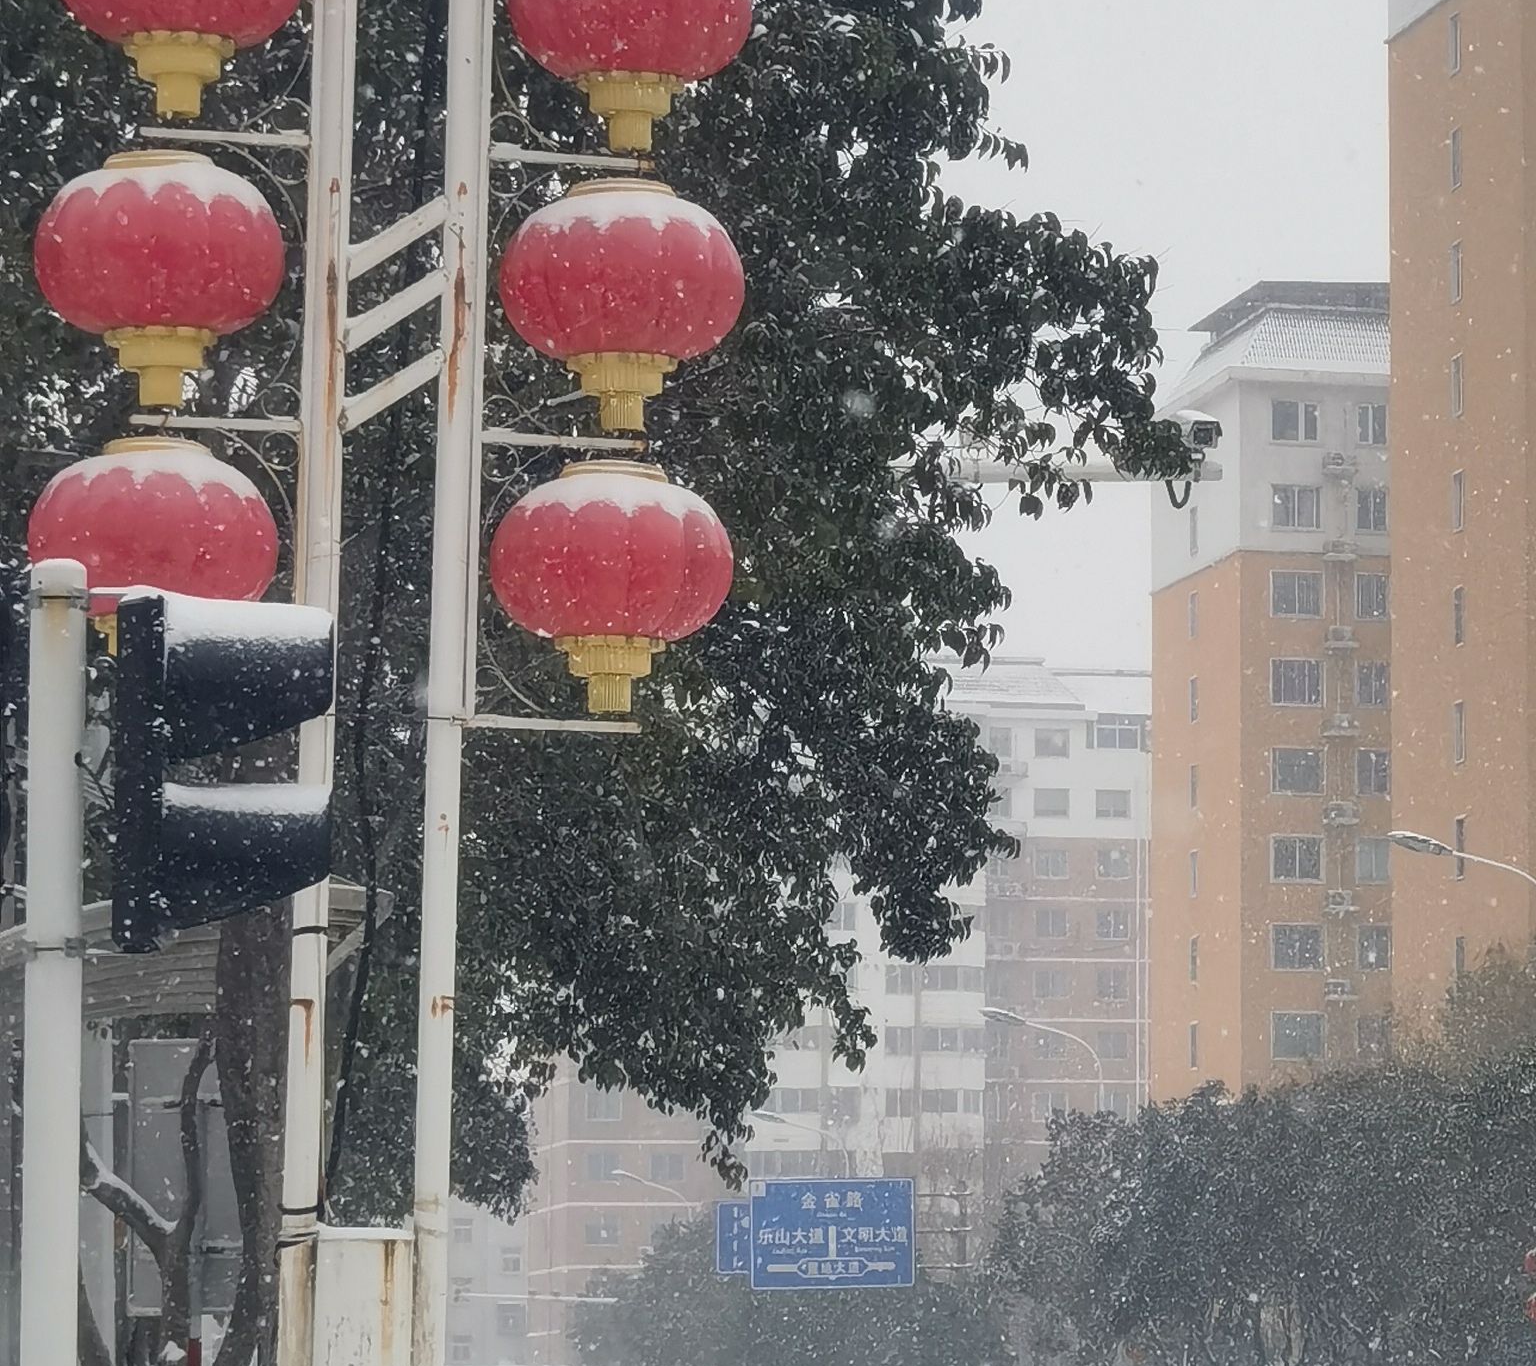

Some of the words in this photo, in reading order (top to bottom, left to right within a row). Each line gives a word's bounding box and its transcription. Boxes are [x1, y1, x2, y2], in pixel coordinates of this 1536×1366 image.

[801, 1191, 863, 1210] 金雀路
[758, 1227, 825, 1245] 乐山大道
[840, 1226, 908, 1244] 文明大道
